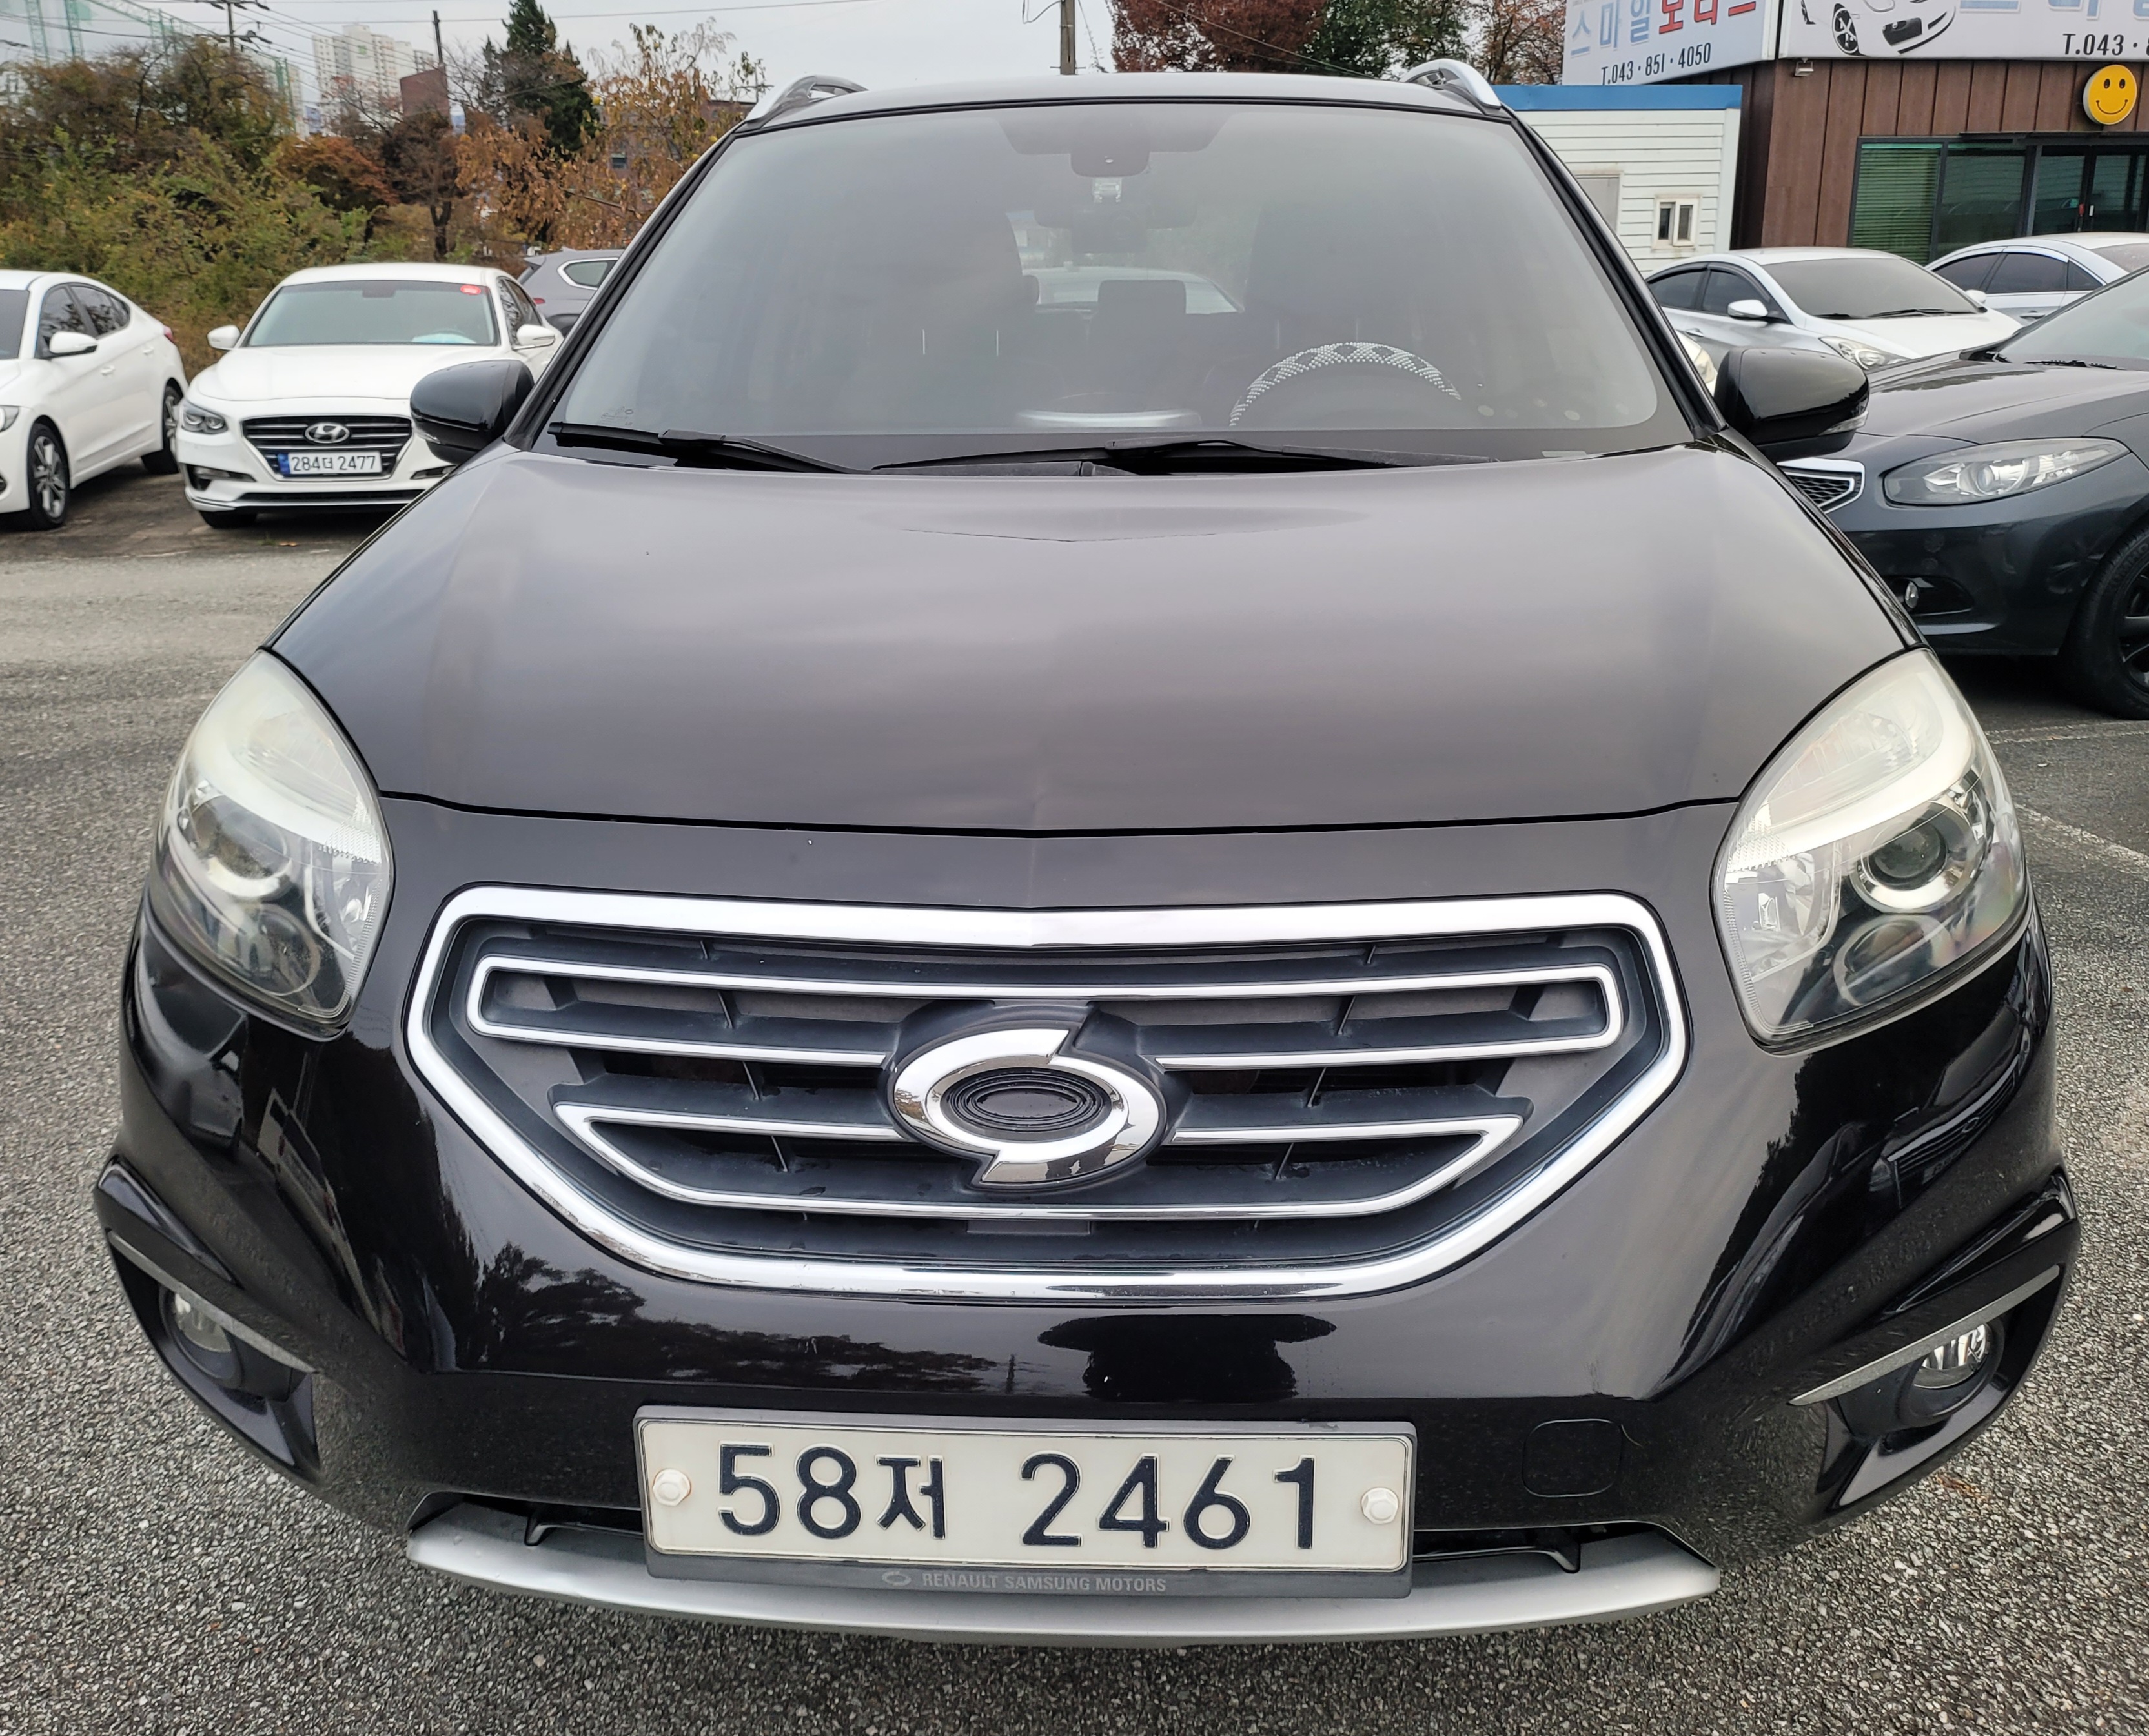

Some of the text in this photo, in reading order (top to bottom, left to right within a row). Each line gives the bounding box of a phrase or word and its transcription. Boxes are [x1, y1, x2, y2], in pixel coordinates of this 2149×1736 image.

[337, 455, 376, 471] 2477
[718, 1443, 1316, 1551] 58저 2461
[922, 1572, 1167, 1593] RENAULT SAMSUNG MOTORS
